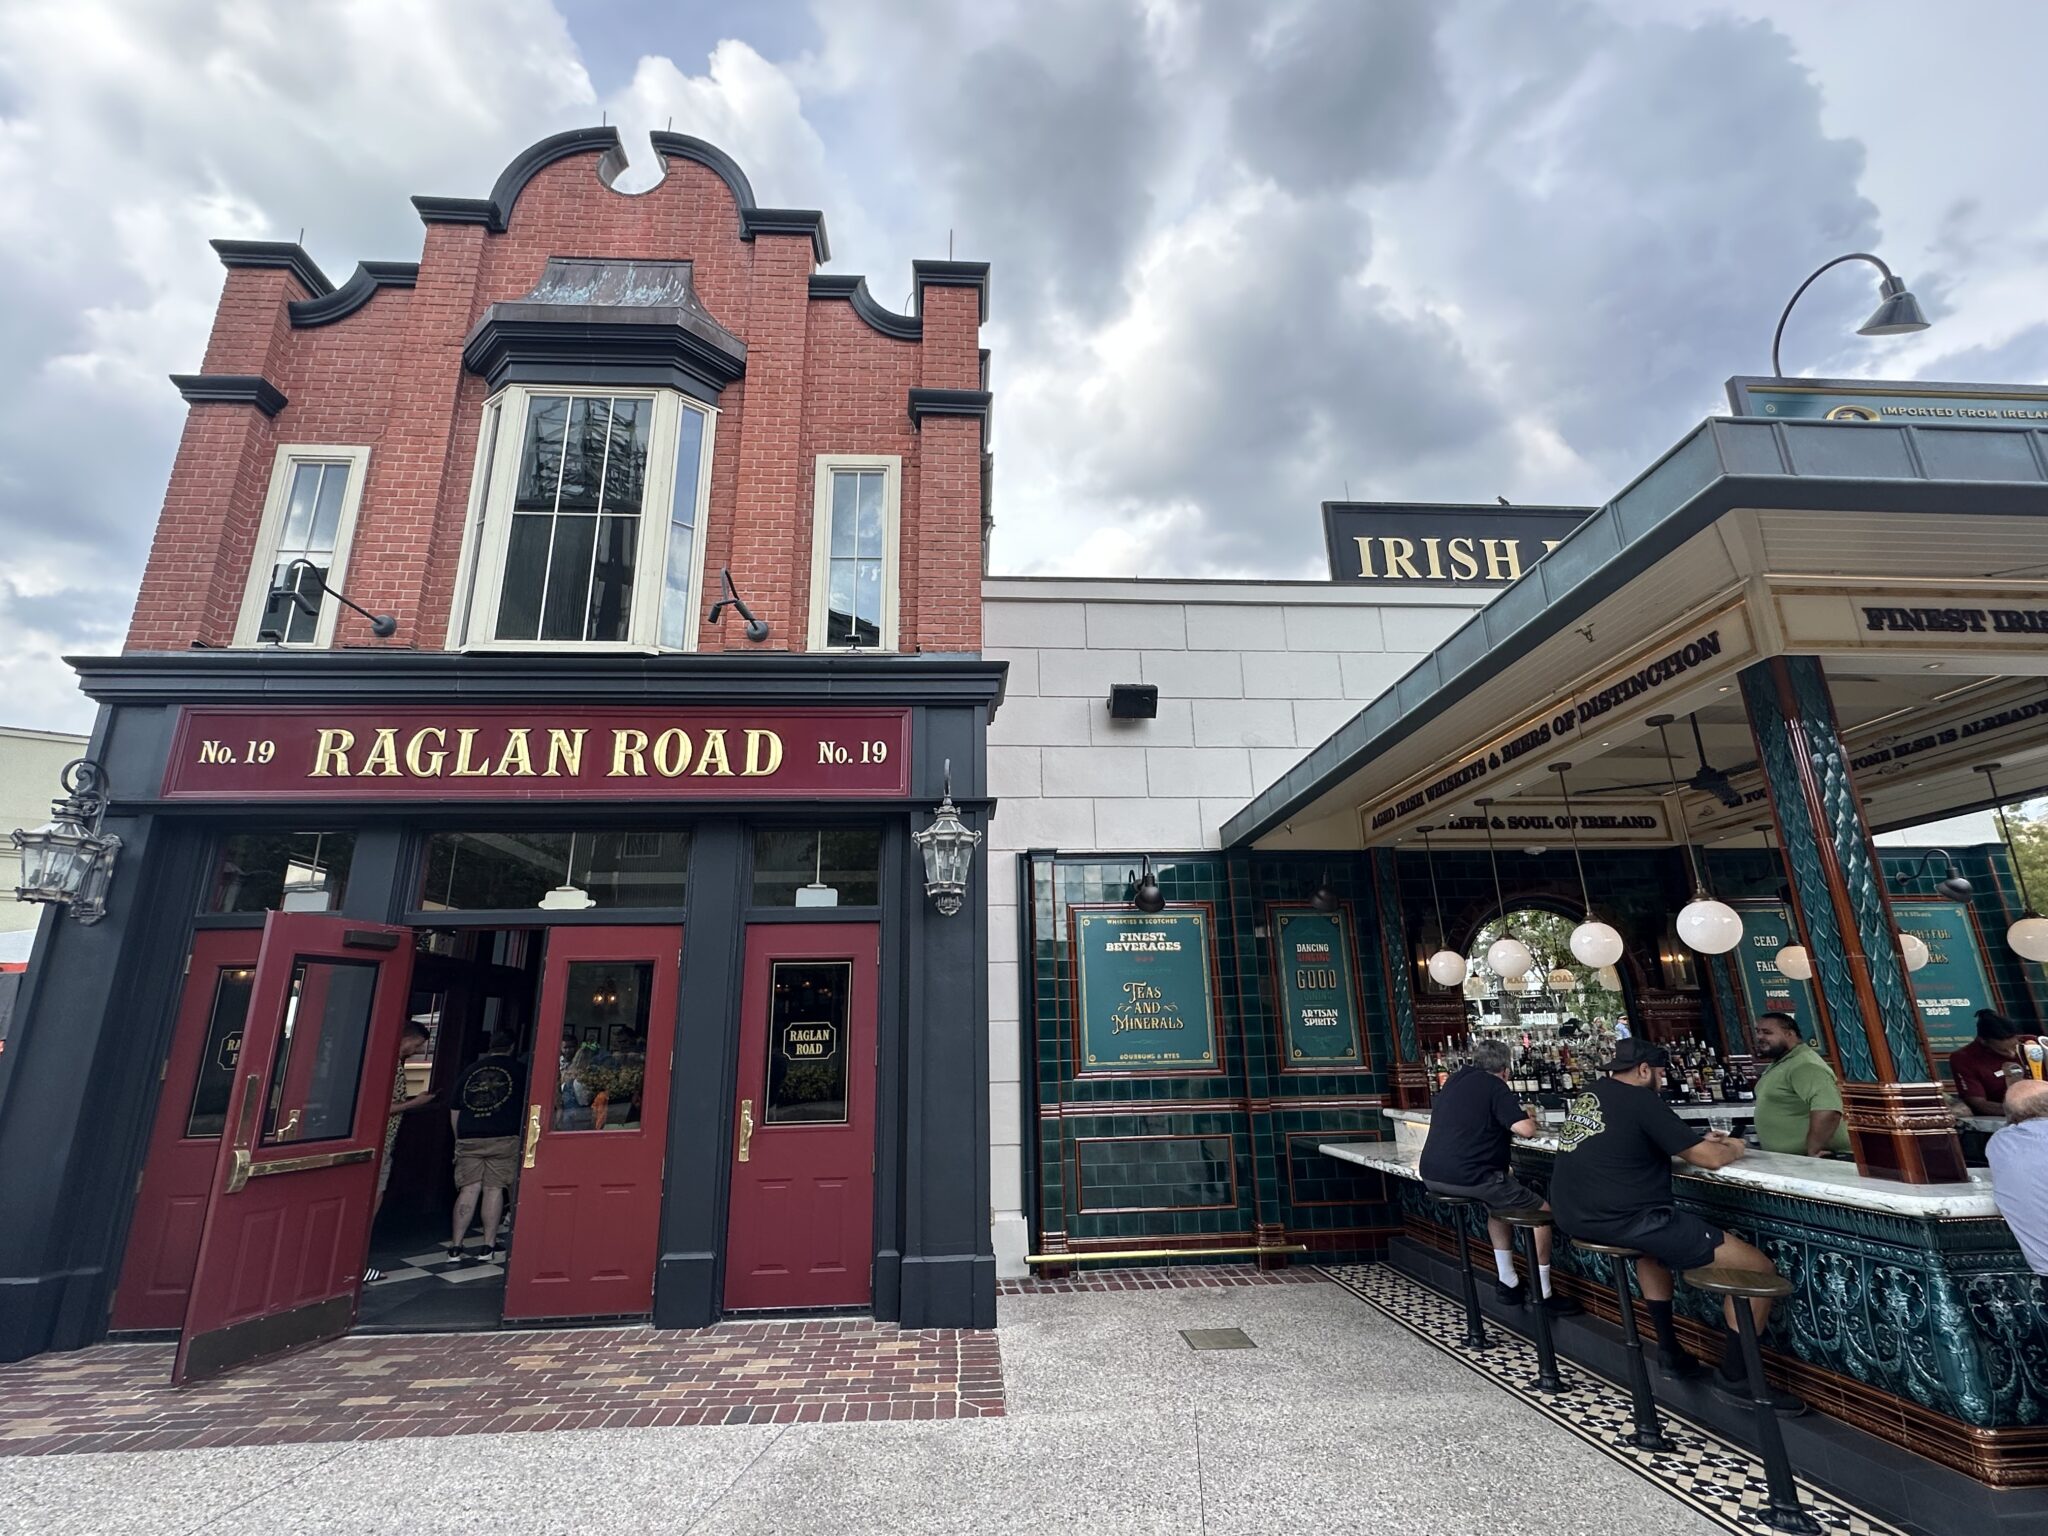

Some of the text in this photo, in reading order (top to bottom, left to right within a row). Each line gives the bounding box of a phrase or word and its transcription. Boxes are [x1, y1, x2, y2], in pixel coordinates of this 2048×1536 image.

[1882, 406, 1954, 417] IMPORTED
[1958, 408, 1997, 419] FROM
[1353, 536, 1522, 580] IRISH
[1861, 607, 1988, 633] FINEST
[1372, 630, 1723, 831] AGED IRISH WHISKEYS & BEERS OF DISTINCTION
[1937, 728, 1959, 745] IS
[198, 740, 276, 765] No. 19
[307, 727, 783, 778] RAGLAN ROAD
[817, 740, 888, 764] No. 19
[1490, 816, 1505, 830] &
[1507, 816, 1554, 830] SOUL
[1580, 816, 1658, 830] IRELAND
[1119, 932, 1167, 942] FINEST
[1105, 941, 1182, 952] BEVERAGES
[1296, 943, 1329, 953] DANCING
[1756, 960, 1781, 972] FAIL
[1296, 969, 1337, 989] GOOD
[1123, 981, 1162, 1004] TEAS
[1134, 1001, 1161, 1014] AND
[1301, 1008, 1339, 1018] ARTISAN
[1111, 1014, 1184, 1035] MINERALS
[1304, 1017, 1338, 1027] SPIRITS
[789, 1029, 831, 1042] RAGLAN
[795, 1043, 823, 1055] ROAD
